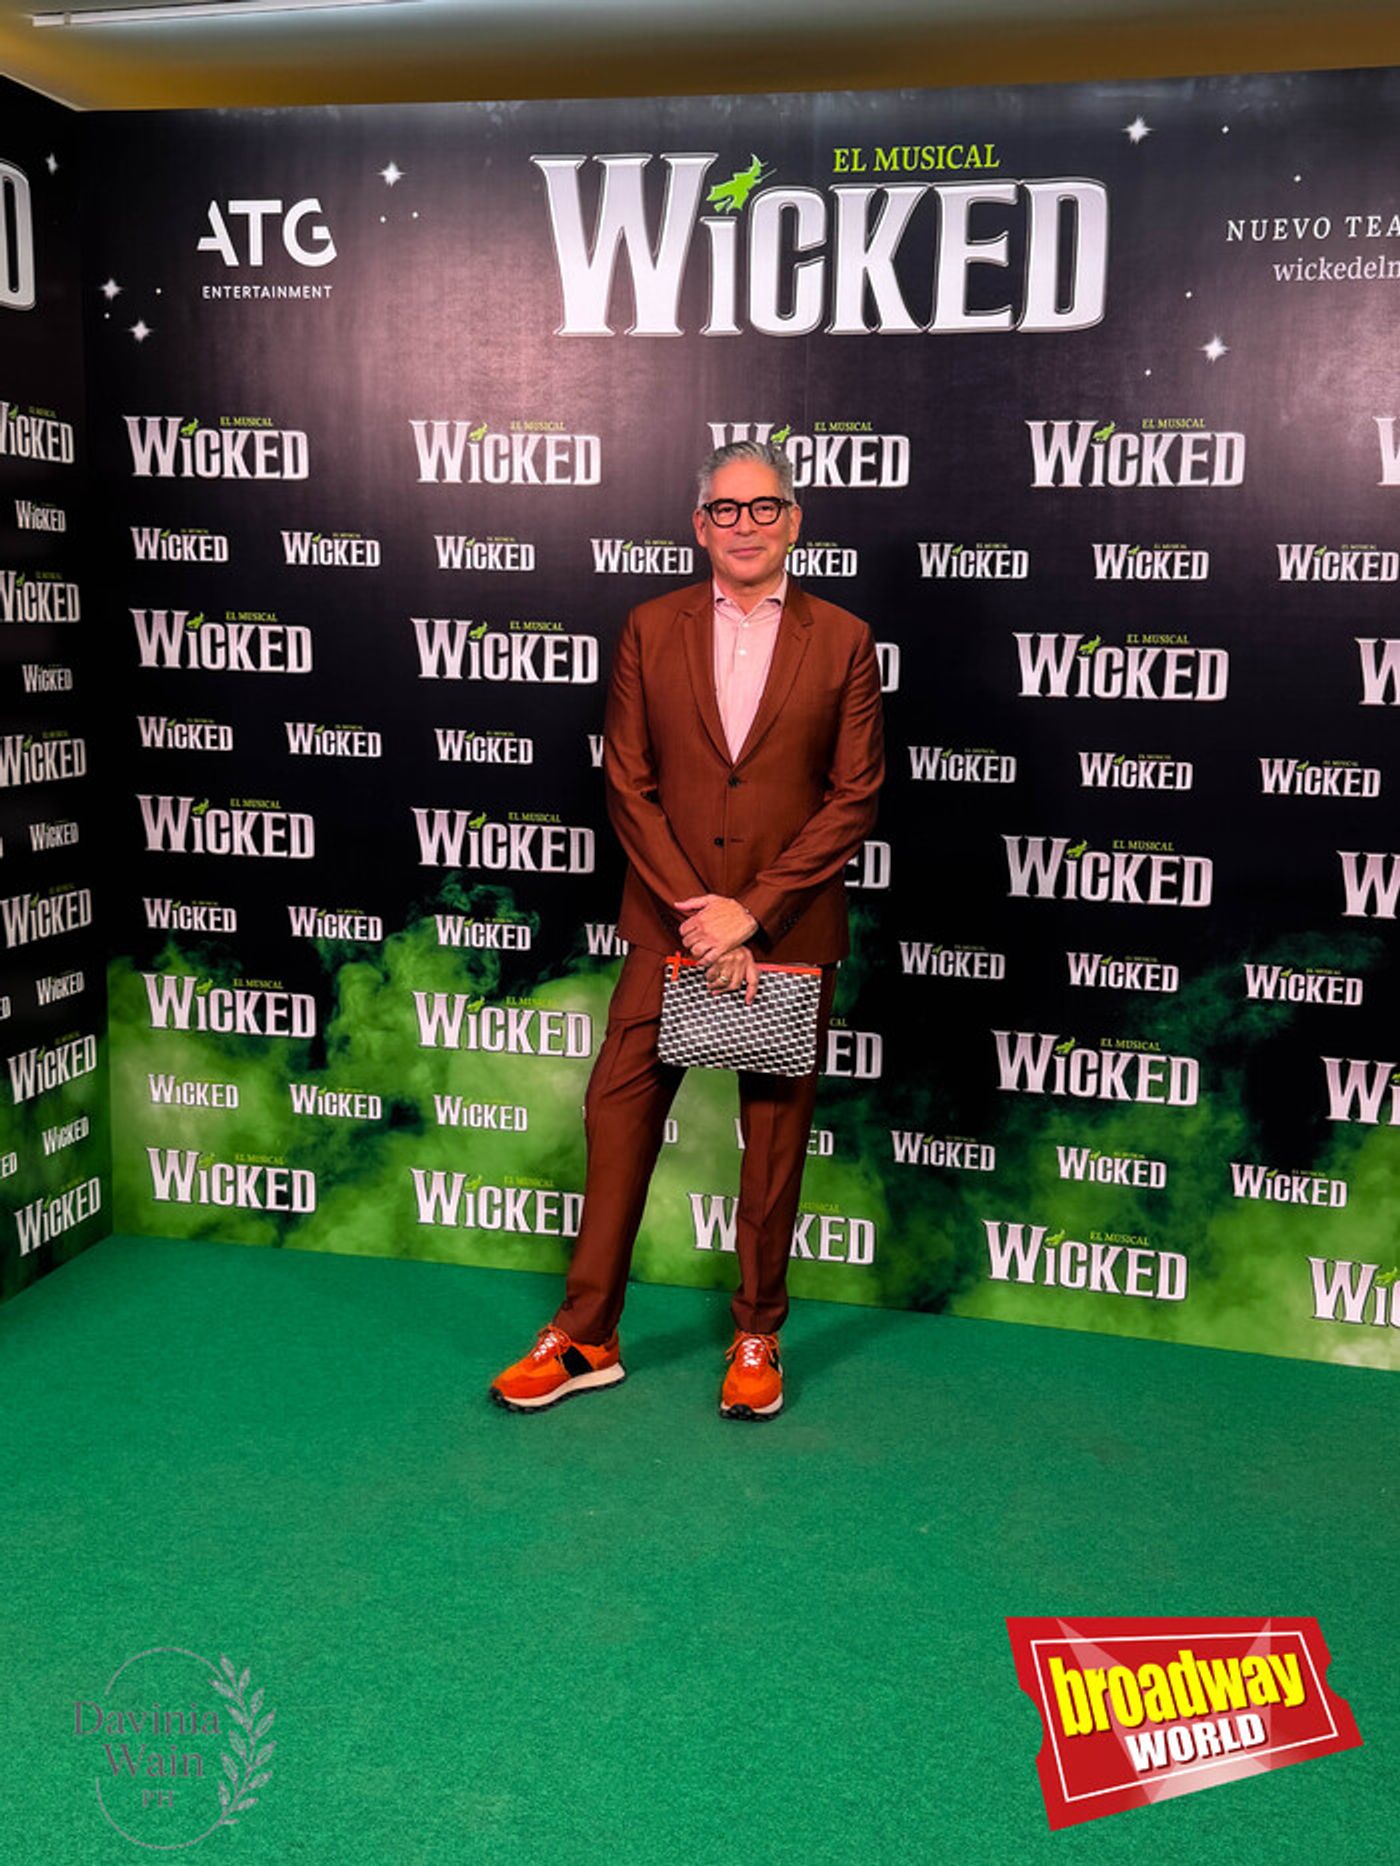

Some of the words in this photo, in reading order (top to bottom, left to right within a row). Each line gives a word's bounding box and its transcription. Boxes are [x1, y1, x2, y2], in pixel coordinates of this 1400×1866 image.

[833, 147, 867, 174] EL
[873, 143, 1001, 172] MUSICAL
[197, 199, 338, 267] ATG
[1226, 216, 1331, 242] NUEVO
[1345, 214, 1400, 238] TEA
[202, 284, 333, 299] ENTERTAINMENT
[1142, 419, 1156, 429] EL
[1158, 418, 1205, 429] MUSICAL
[1127, 634, 1139, 644] EL
[1143, 635, 1190, 645] MUSICAL
[1113, 840, 1125, 850] EL
[1128, 840, 1174, 852] MUSICAL
[1101, 1039, 1113, 1049] EL
[1116, 1040, 1161, 1051] MUSICAL
